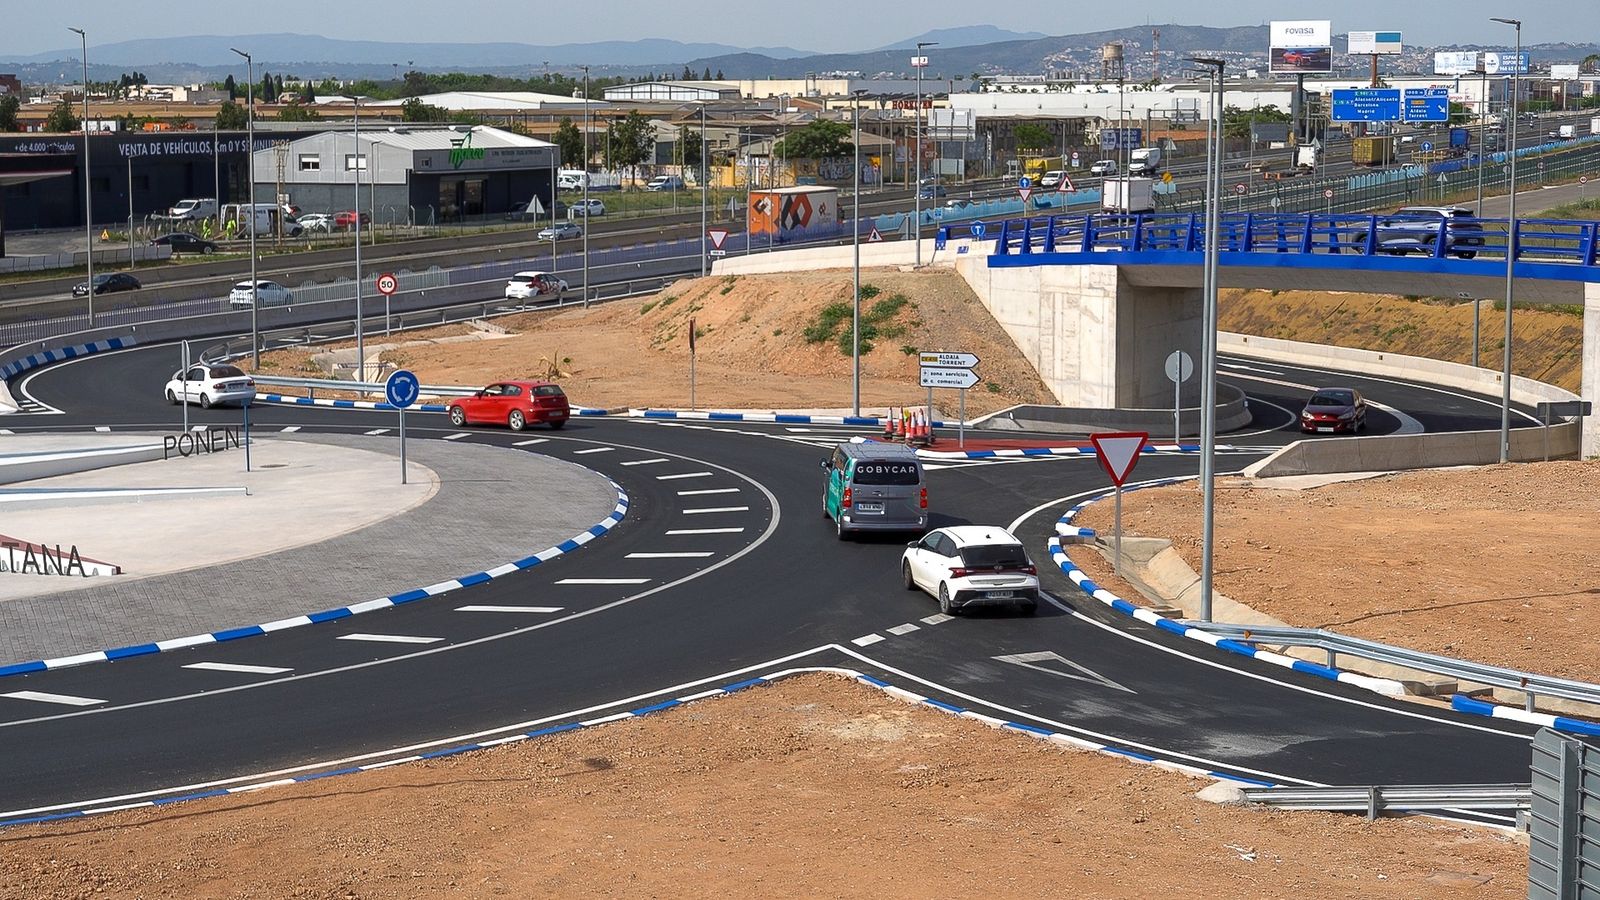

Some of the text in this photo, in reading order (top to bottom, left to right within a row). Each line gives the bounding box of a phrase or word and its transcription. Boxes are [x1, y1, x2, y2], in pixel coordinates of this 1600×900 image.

[119, 143, 148, 156] VENTA
[151, 142, 161, 155] DE
[235, 140, 240, 152] Y
[381, 280, 393, 288] 50
[857, 466, 915, 474] GOBYCAR
